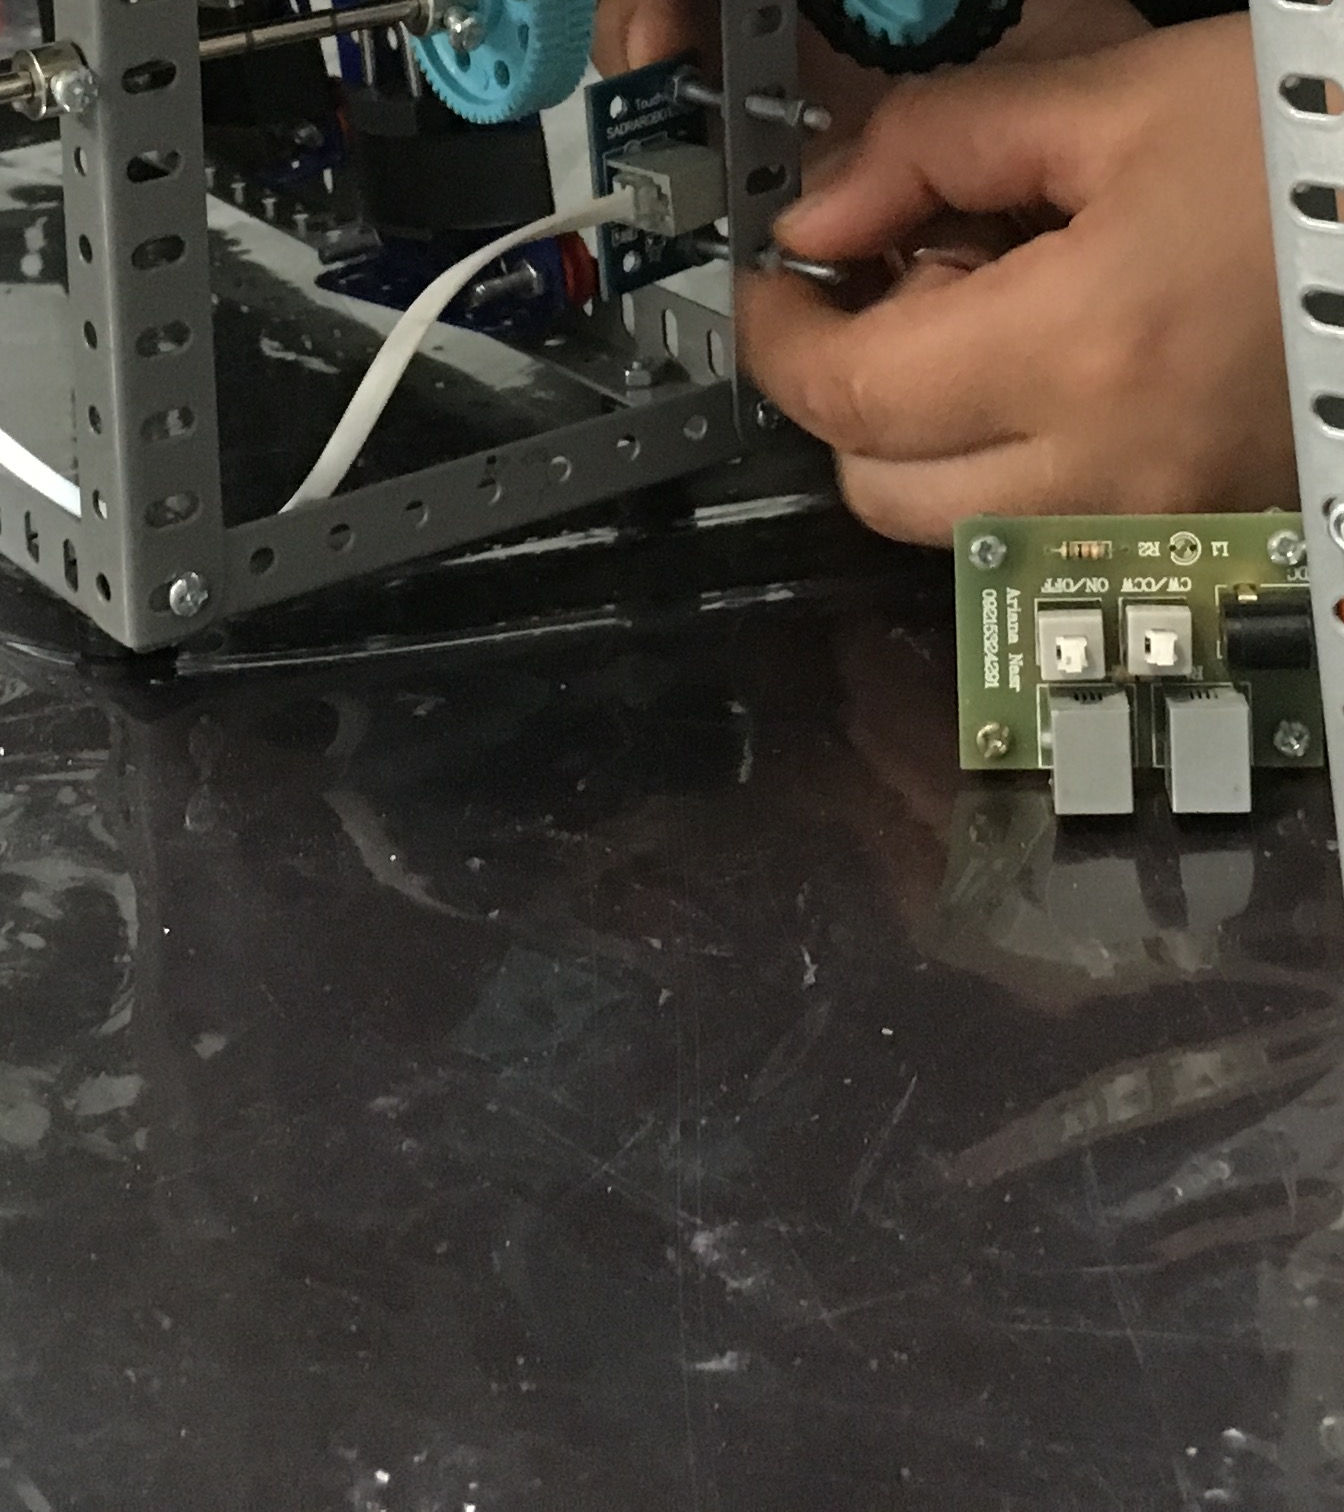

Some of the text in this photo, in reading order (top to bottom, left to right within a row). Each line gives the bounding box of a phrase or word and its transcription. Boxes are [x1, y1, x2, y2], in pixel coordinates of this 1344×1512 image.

[1137, 541, 1161, 557] R2
[1040, 577, 1109, 593] ON/OFF
[1120, 577, 1192, 593] CW/CCW
[1006, 587, 1022, 645] Ariana
